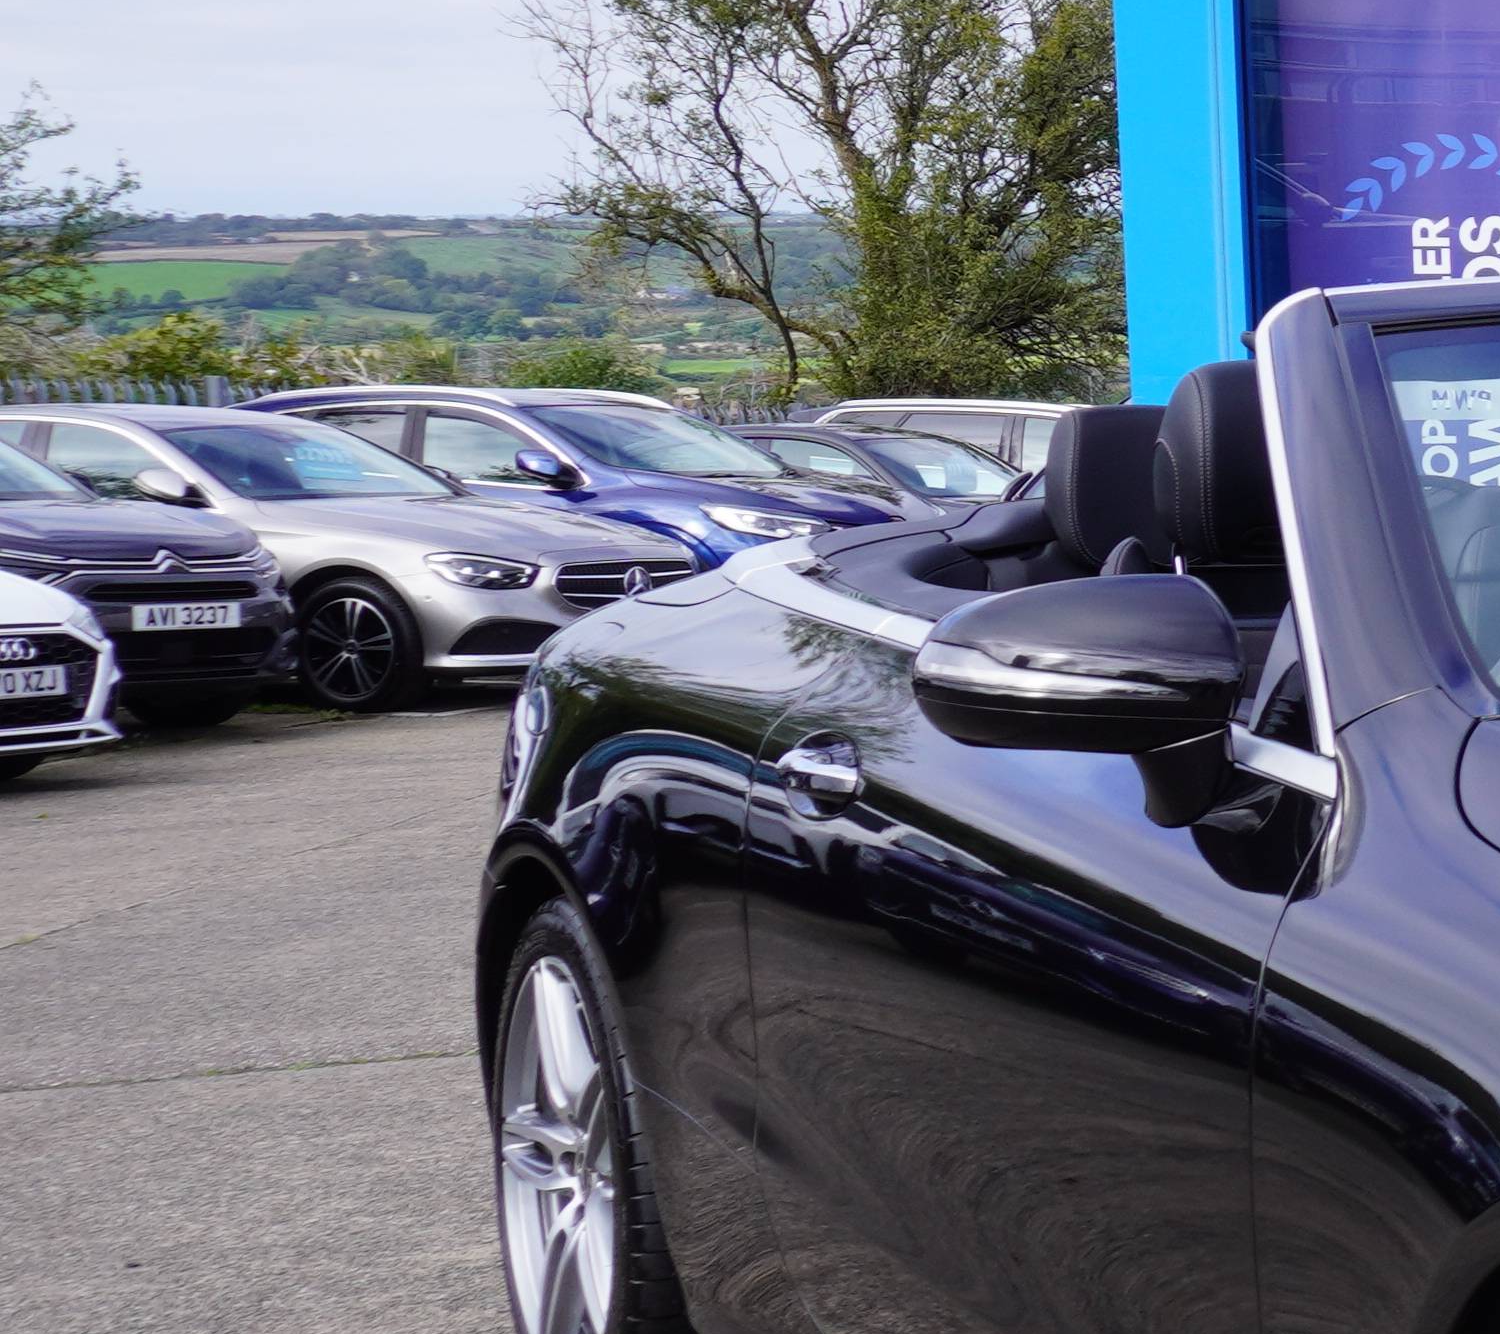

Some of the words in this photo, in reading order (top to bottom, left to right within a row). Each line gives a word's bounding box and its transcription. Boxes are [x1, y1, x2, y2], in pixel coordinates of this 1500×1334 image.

[146, 607, 176, 626] AVI
[181, 605, 229, 625] 3237
[21, 670, 57, 693] XZJ
